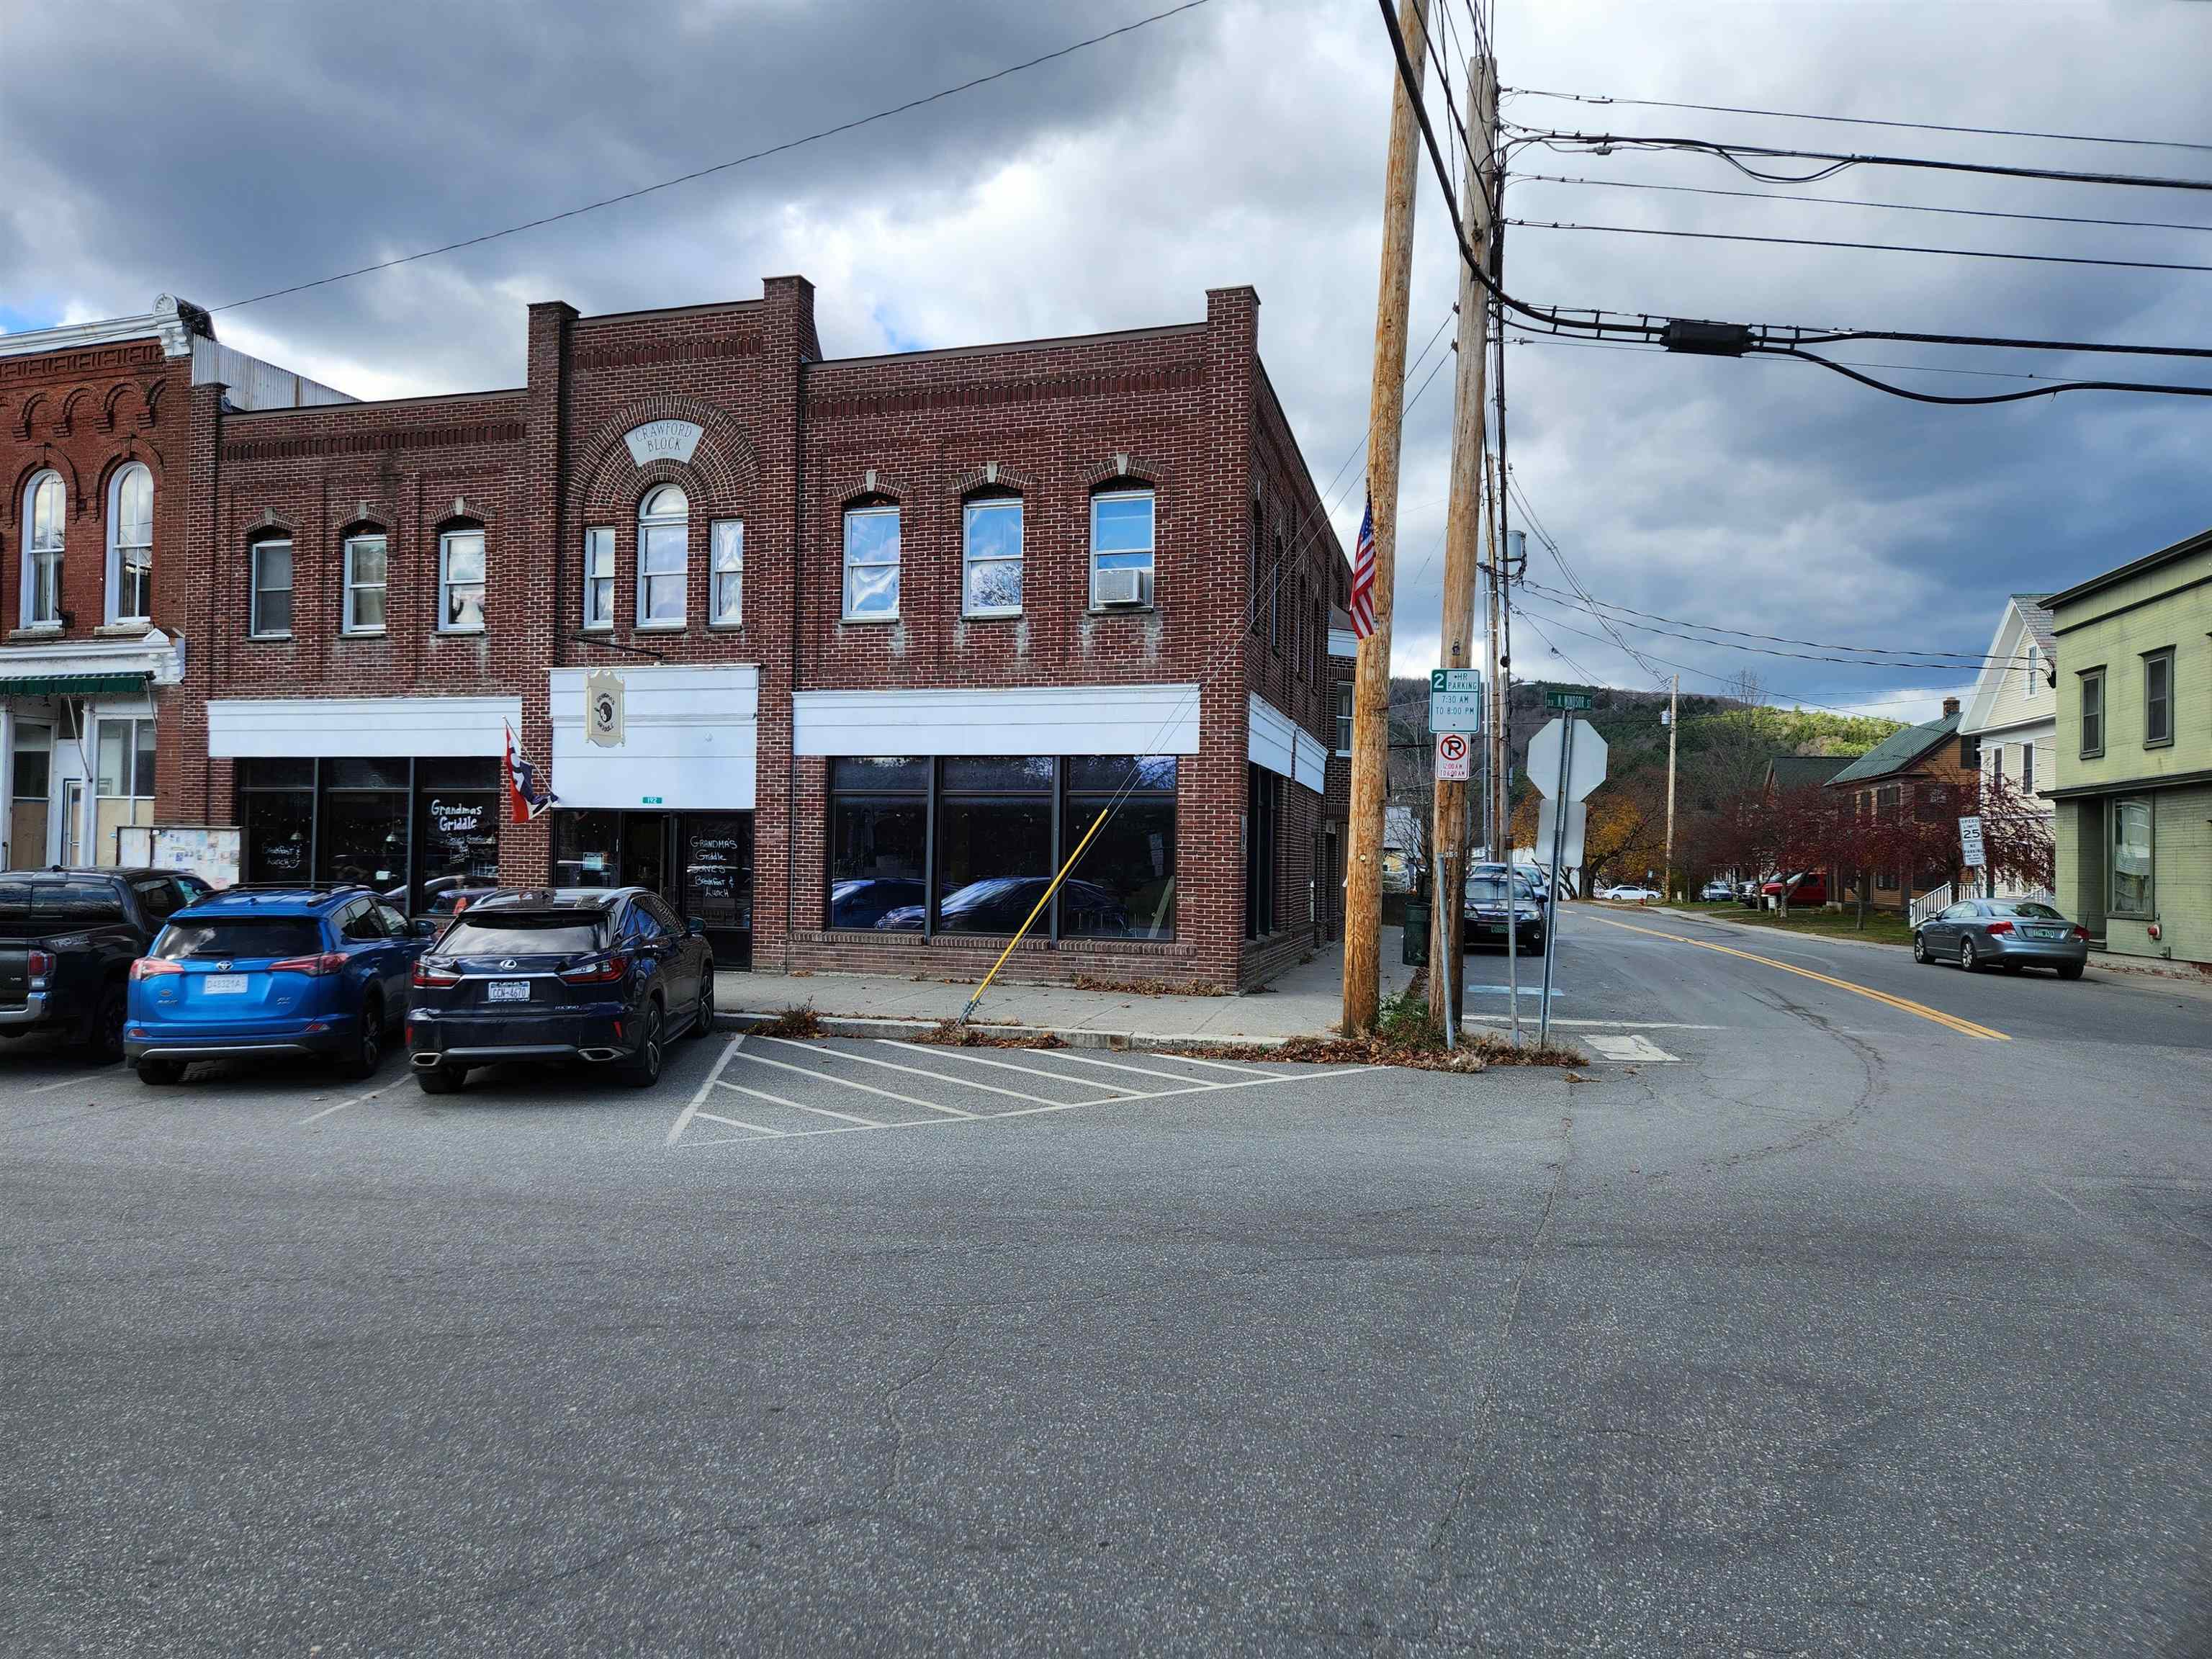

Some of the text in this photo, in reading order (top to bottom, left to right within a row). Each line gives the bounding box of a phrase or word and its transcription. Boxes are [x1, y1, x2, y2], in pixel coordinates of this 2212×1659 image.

[635, 422, 692, 442] CRAWFORD
[647, 437, 680, 452] BLOCK
[1434, 673, 1444, 688] 2
[1447, 681, 1477, 690] PARKING
[439, 816, 478, 831] Griddle
[1963, 830, 1980, 839] 25
